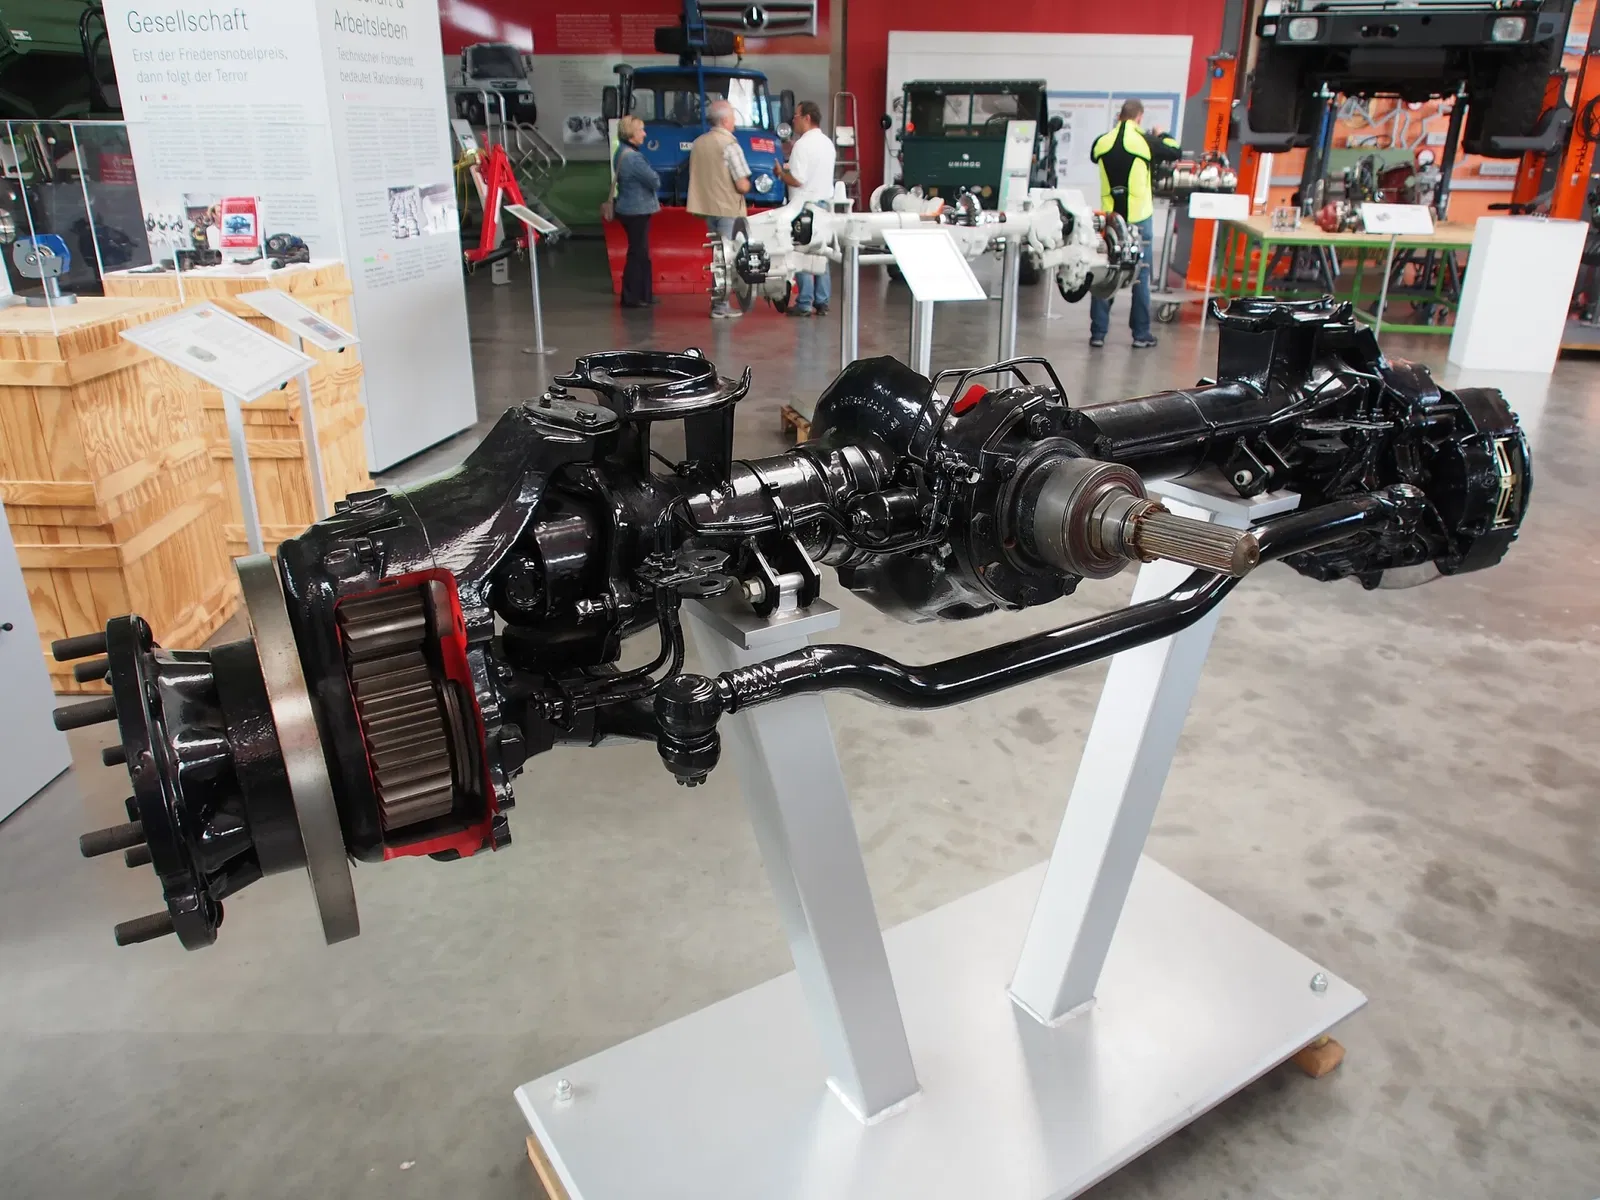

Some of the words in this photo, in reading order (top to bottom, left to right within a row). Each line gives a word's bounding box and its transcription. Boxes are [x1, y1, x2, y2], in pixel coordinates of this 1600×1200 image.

[127, 8, 249, 33] Gesellschaft
[334, 9, 408, 40] Arbeitsleben
[132, 48, 154, 62] Erst
[158, 49, 175, 61] der
[179, 47, 288, 65] Friedensnobelpreis,
[337, 46, 379, 64] Technischer
[137, 70, 163, 83] dann
[166, 69, 190, 86] folgt
[194, 69, 212, 82] der
[215, 68, 248, 82] Terror
[340, 68, 371, 83] bedeutet
